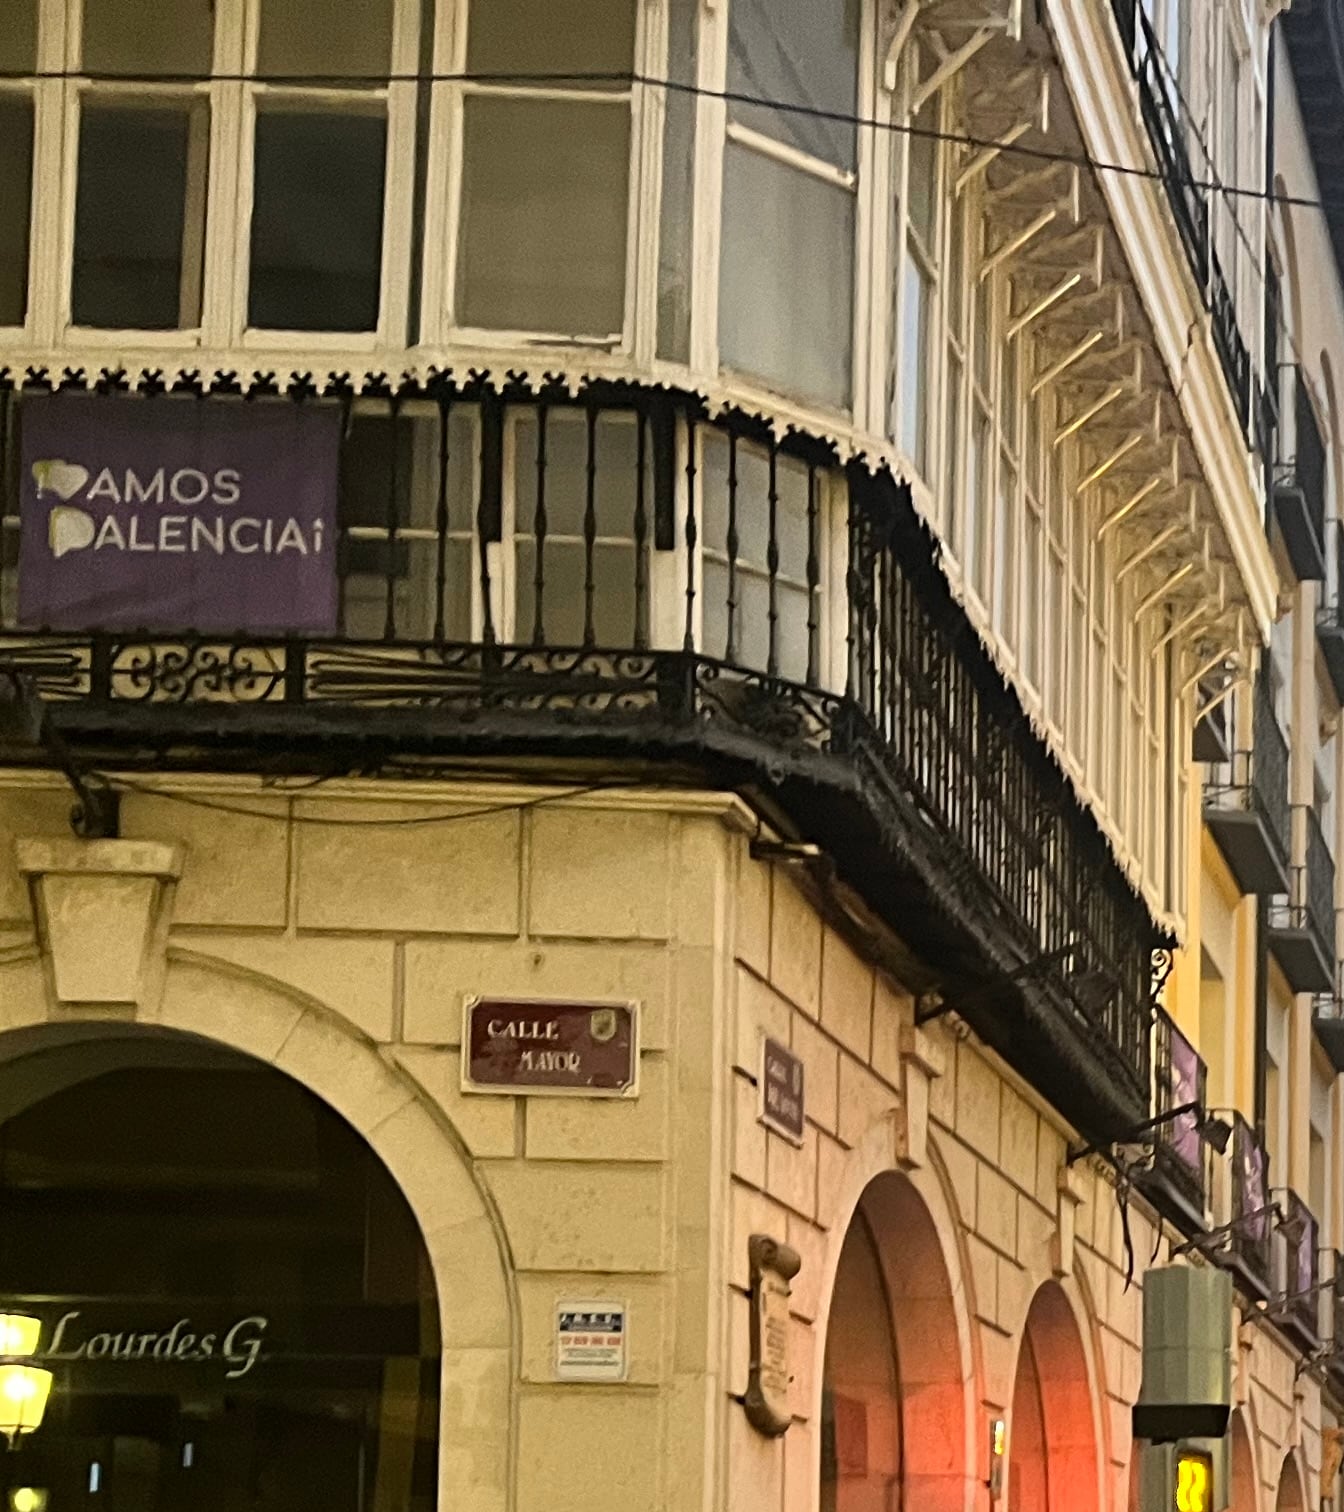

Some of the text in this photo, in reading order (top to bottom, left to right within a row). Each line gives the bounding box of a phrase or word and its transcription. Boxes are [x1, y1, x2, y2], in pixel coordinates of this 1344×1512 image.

[487, 1019, 560, 1041] CALLE
[518, 1050, 582, 1074] MAYOR
[47, 1311, 268, 1378] Lourdes G
